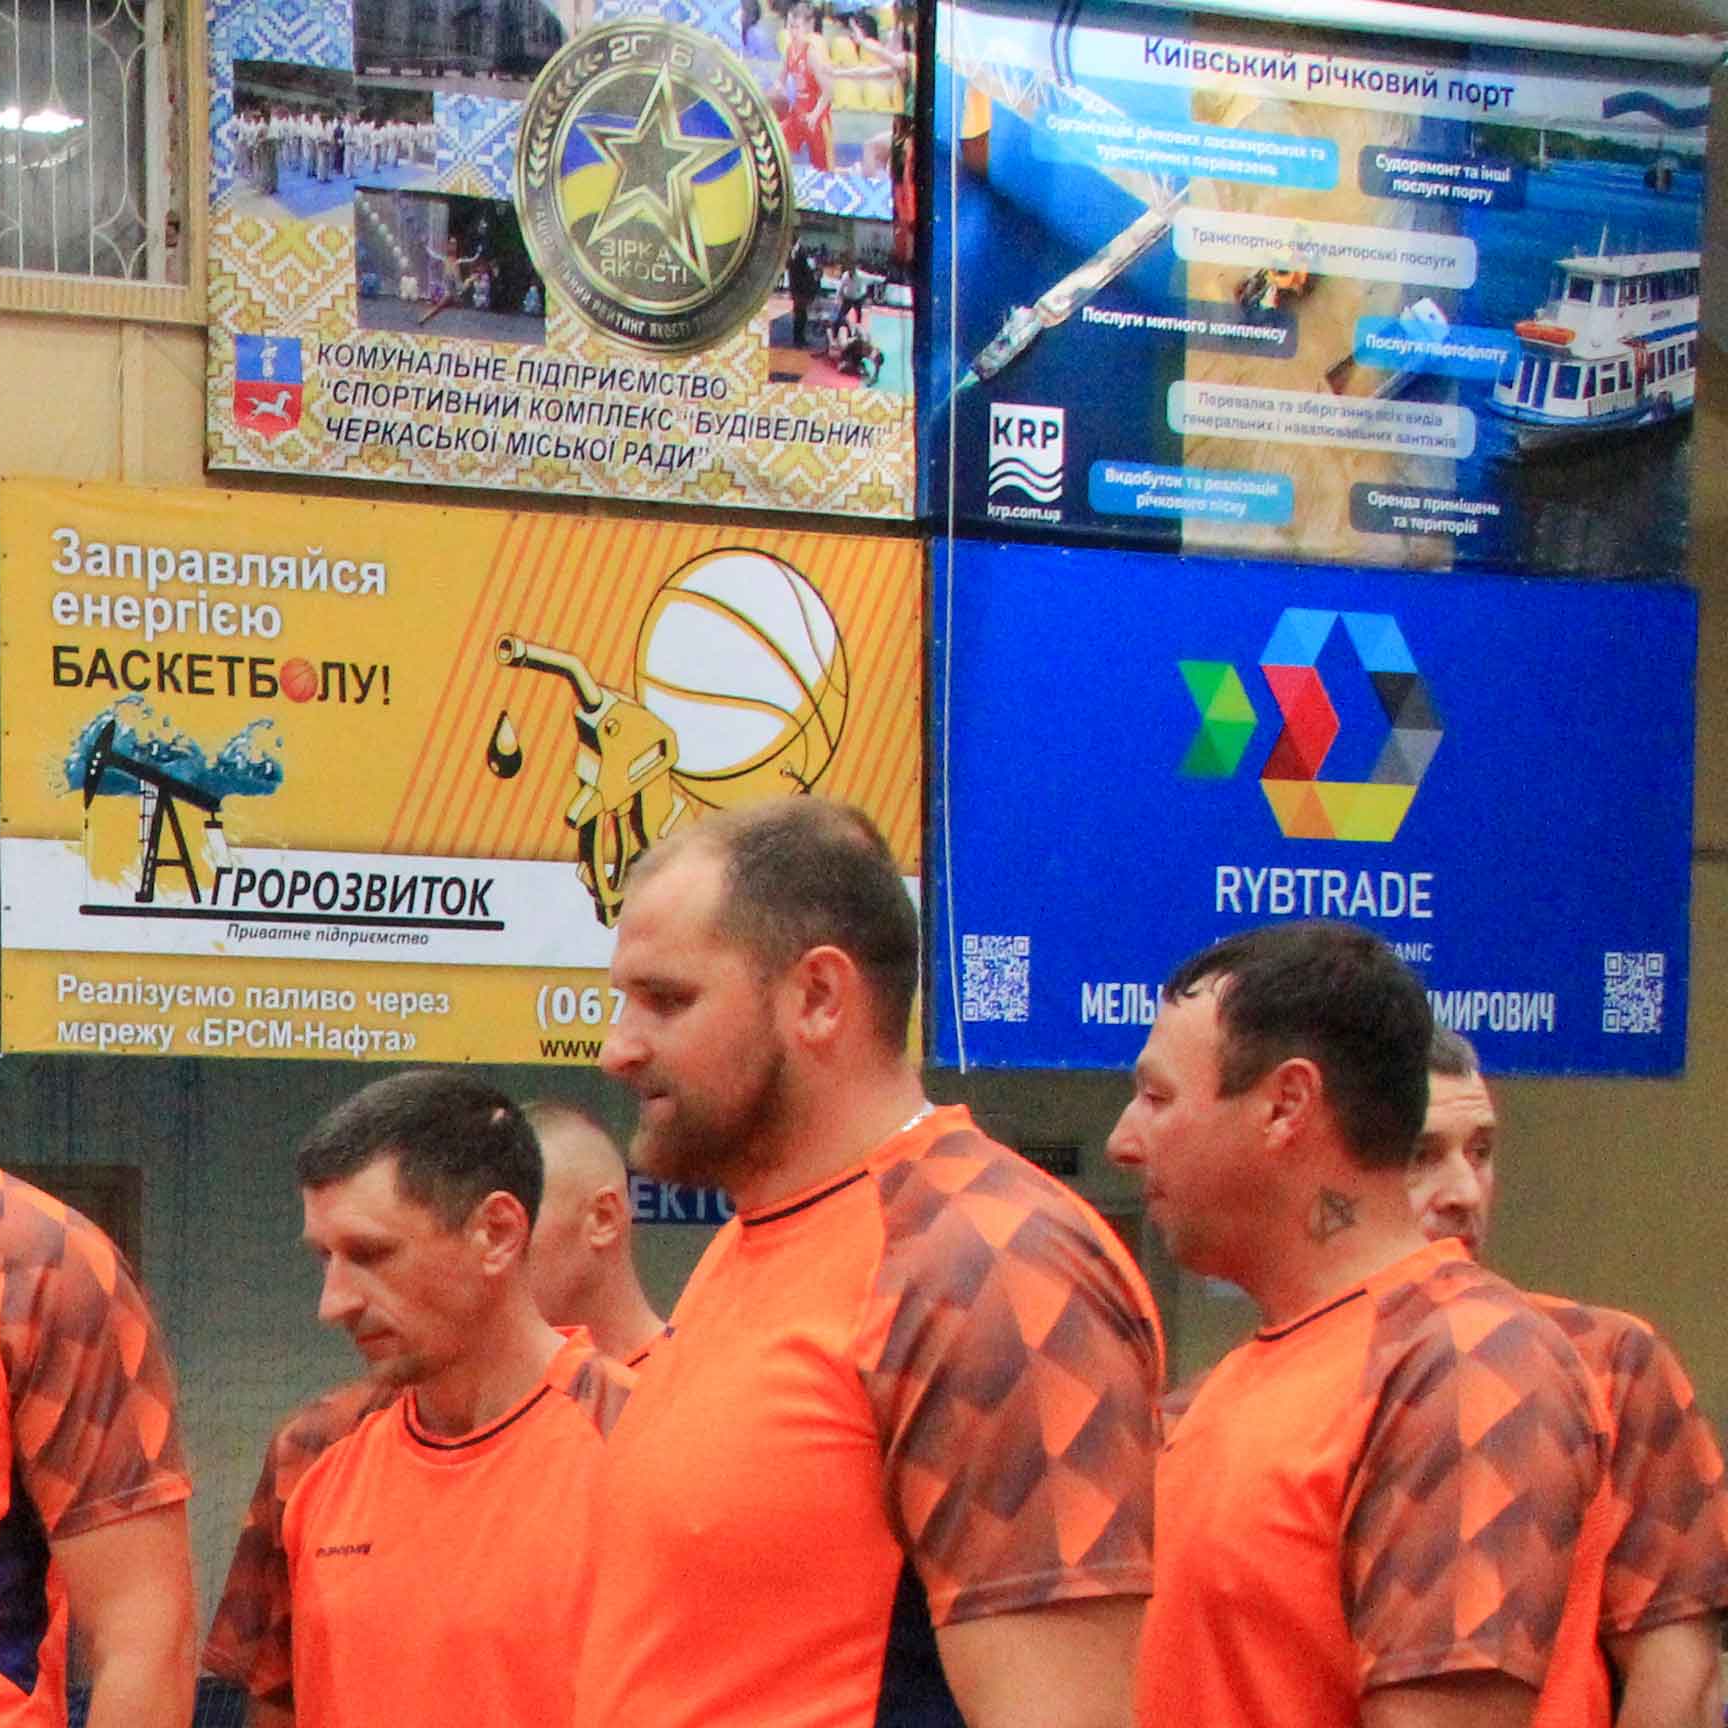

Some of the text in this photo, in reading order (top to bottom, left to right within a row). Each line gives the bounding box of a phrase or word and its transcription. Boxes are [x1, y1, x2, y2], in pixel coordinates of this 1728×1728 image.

[1144, 35, 1514, 112] Київський річковий порт
[1375, 152, 1511, 183] Судоремонт та інші
[1392, 177, 1493, 206] послуги порту
[599, 238, 673, 264] ЗІРКА
[1399, 252, 1456, 271] послуги
[599, 258, 689, 285] ЯКОСТІ
[1082, 305, 1288, 346] Послуги митного комплексу
[317, 344, 728, 400] КОМУНАЛЬНЕ ПІДПРИЄМСТВО
[529, 399, 673, 431] КОМПЛЕКС
[325, 416, 496, 454] ЧЕРКАСЬКОЇ
[505, 431, 619, 463] МІСЬКОЇ
[992, 416, 1060, 450] KRP
[986, 502, 1062, 523] krp.com.ua
[1366, 490, 1421, 510] Оренда
[1392, 514, 1479, 535] та територій
[51, 527, 388, 596] Заправляйся
[51, 590, 282, 642] енергією
[1215, 866, 1434, 919] RYBTRADE
[226, 922, 430, 949] Приватне підприємство
[57, 973, 451, 1020] Реалізуємо паливо через
[536, 985, 627, 1031] (067
[56, 1017, 417, 1057] мережу «БРСМ-Нафта»
